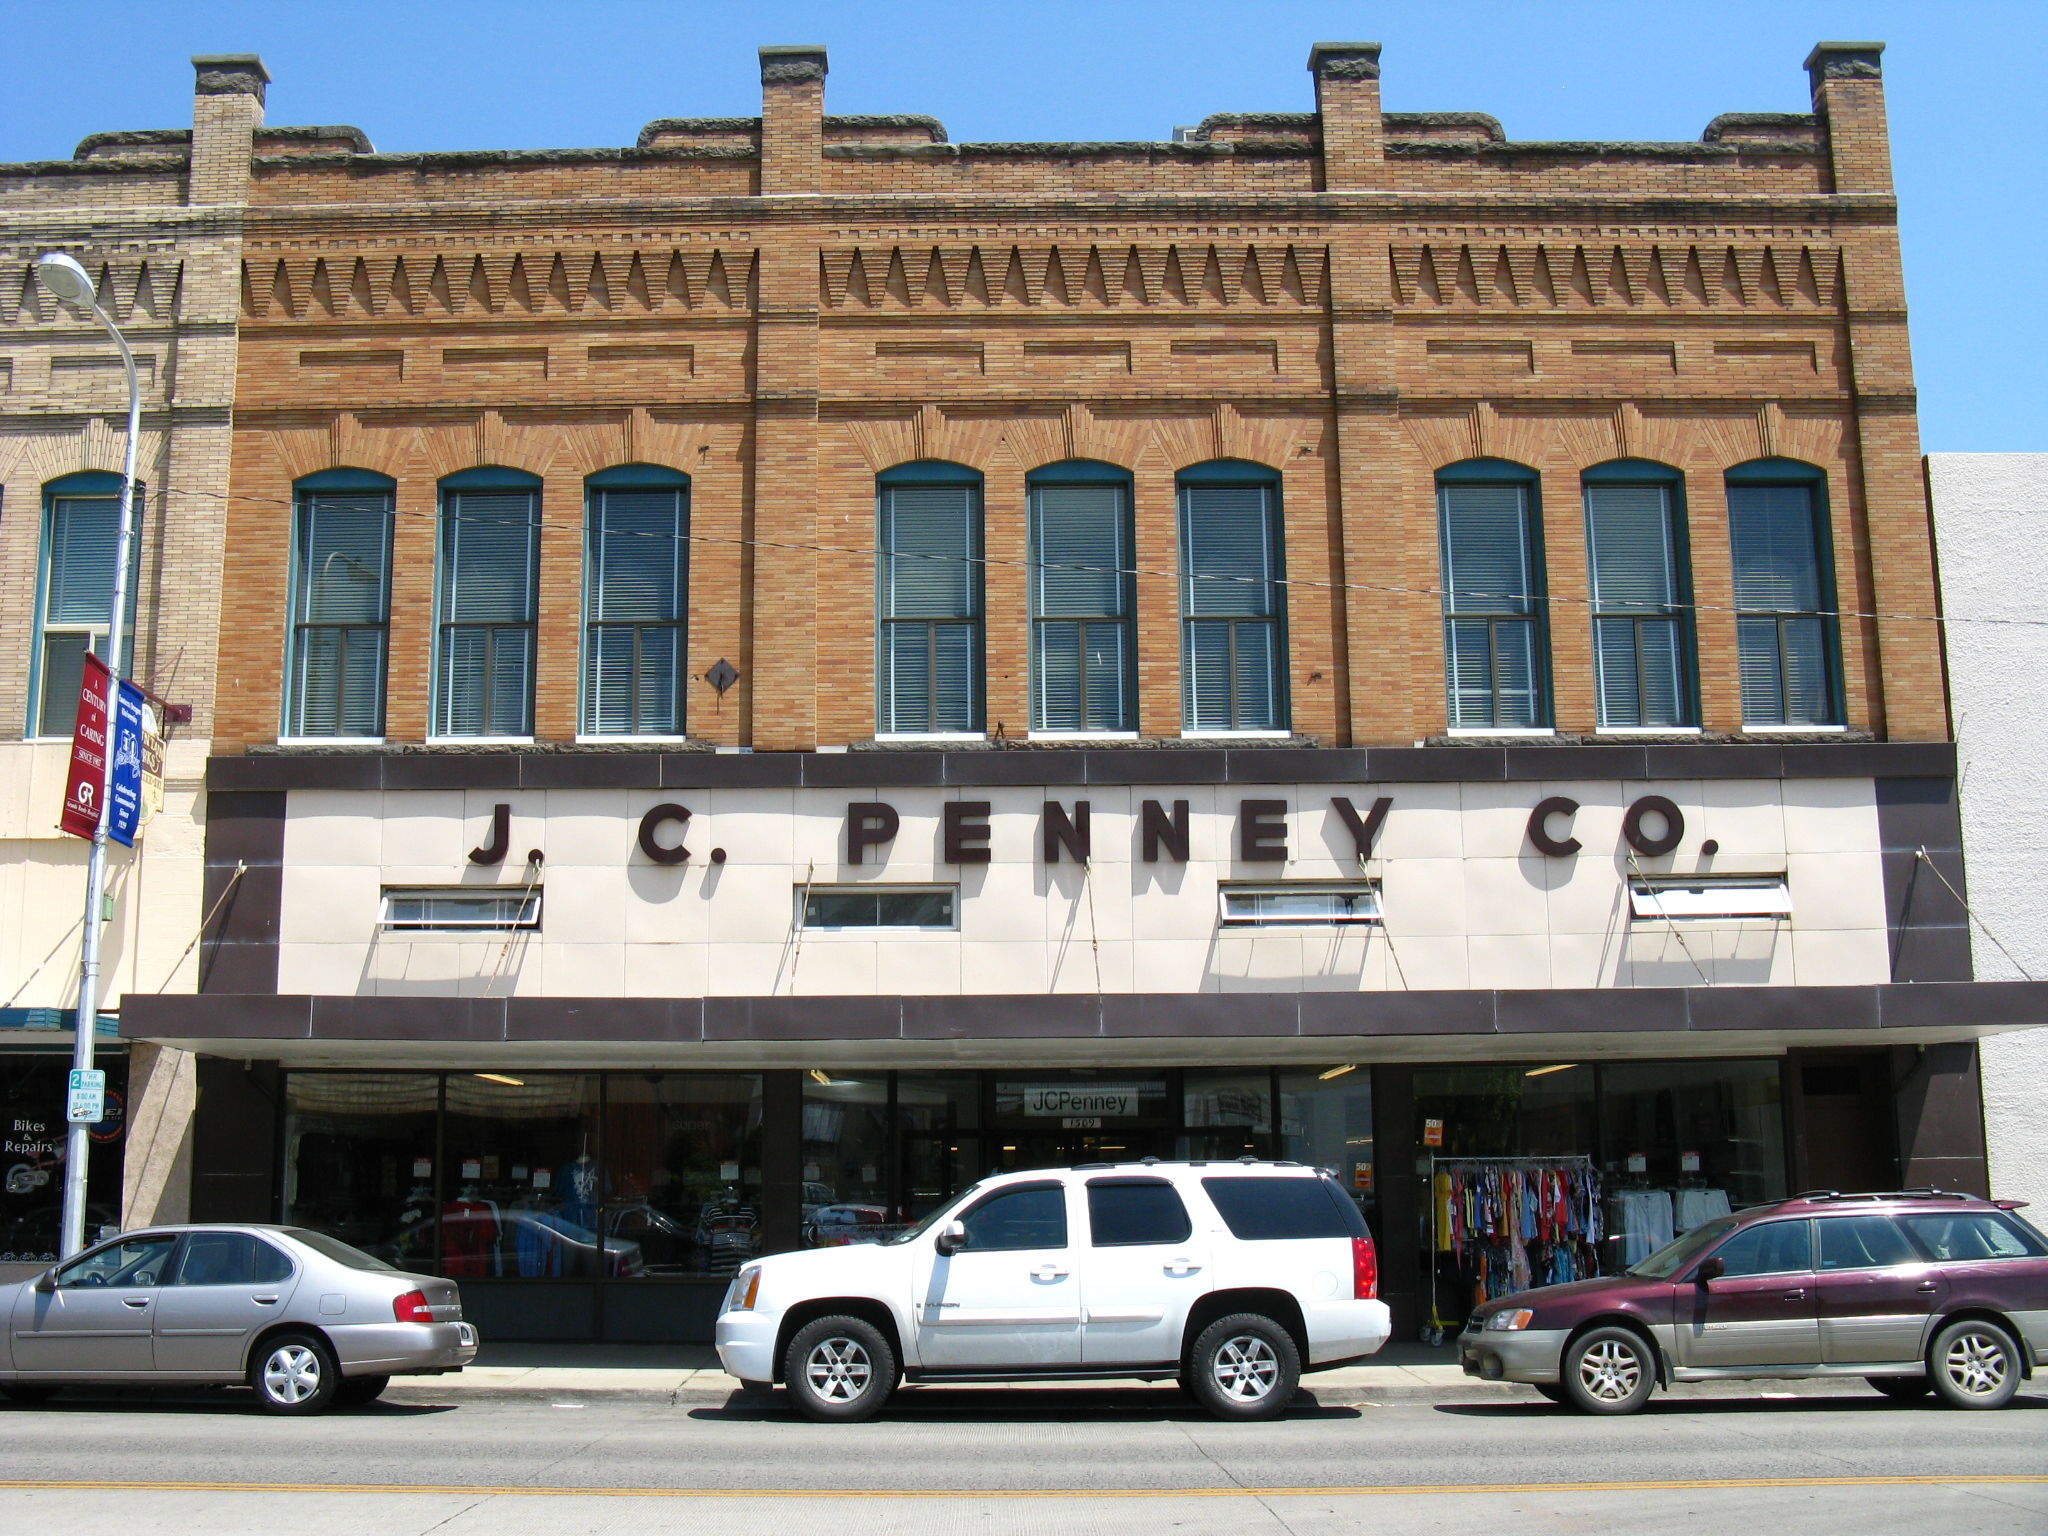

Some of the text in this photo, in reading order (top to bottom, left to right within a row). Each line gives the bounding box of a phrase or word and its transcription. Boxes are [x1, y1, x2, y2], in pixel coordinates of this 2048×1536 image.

[82, 688, 106, 713] CENTURY
[80, 724, 105, 746] CARING
[79, 749, 92, 763] SINCE
[468, 794, 1719, 868] J. C. PENNEY CO.
[72, 1073, 80, 1087] 2
[1033, 1090, 1128, 1114] JCPenney
[14, 1119, 46, 1132] Bikes
[23, 1133, 33, 1141] &
[5, 1140, 53, 1154] Repairs
